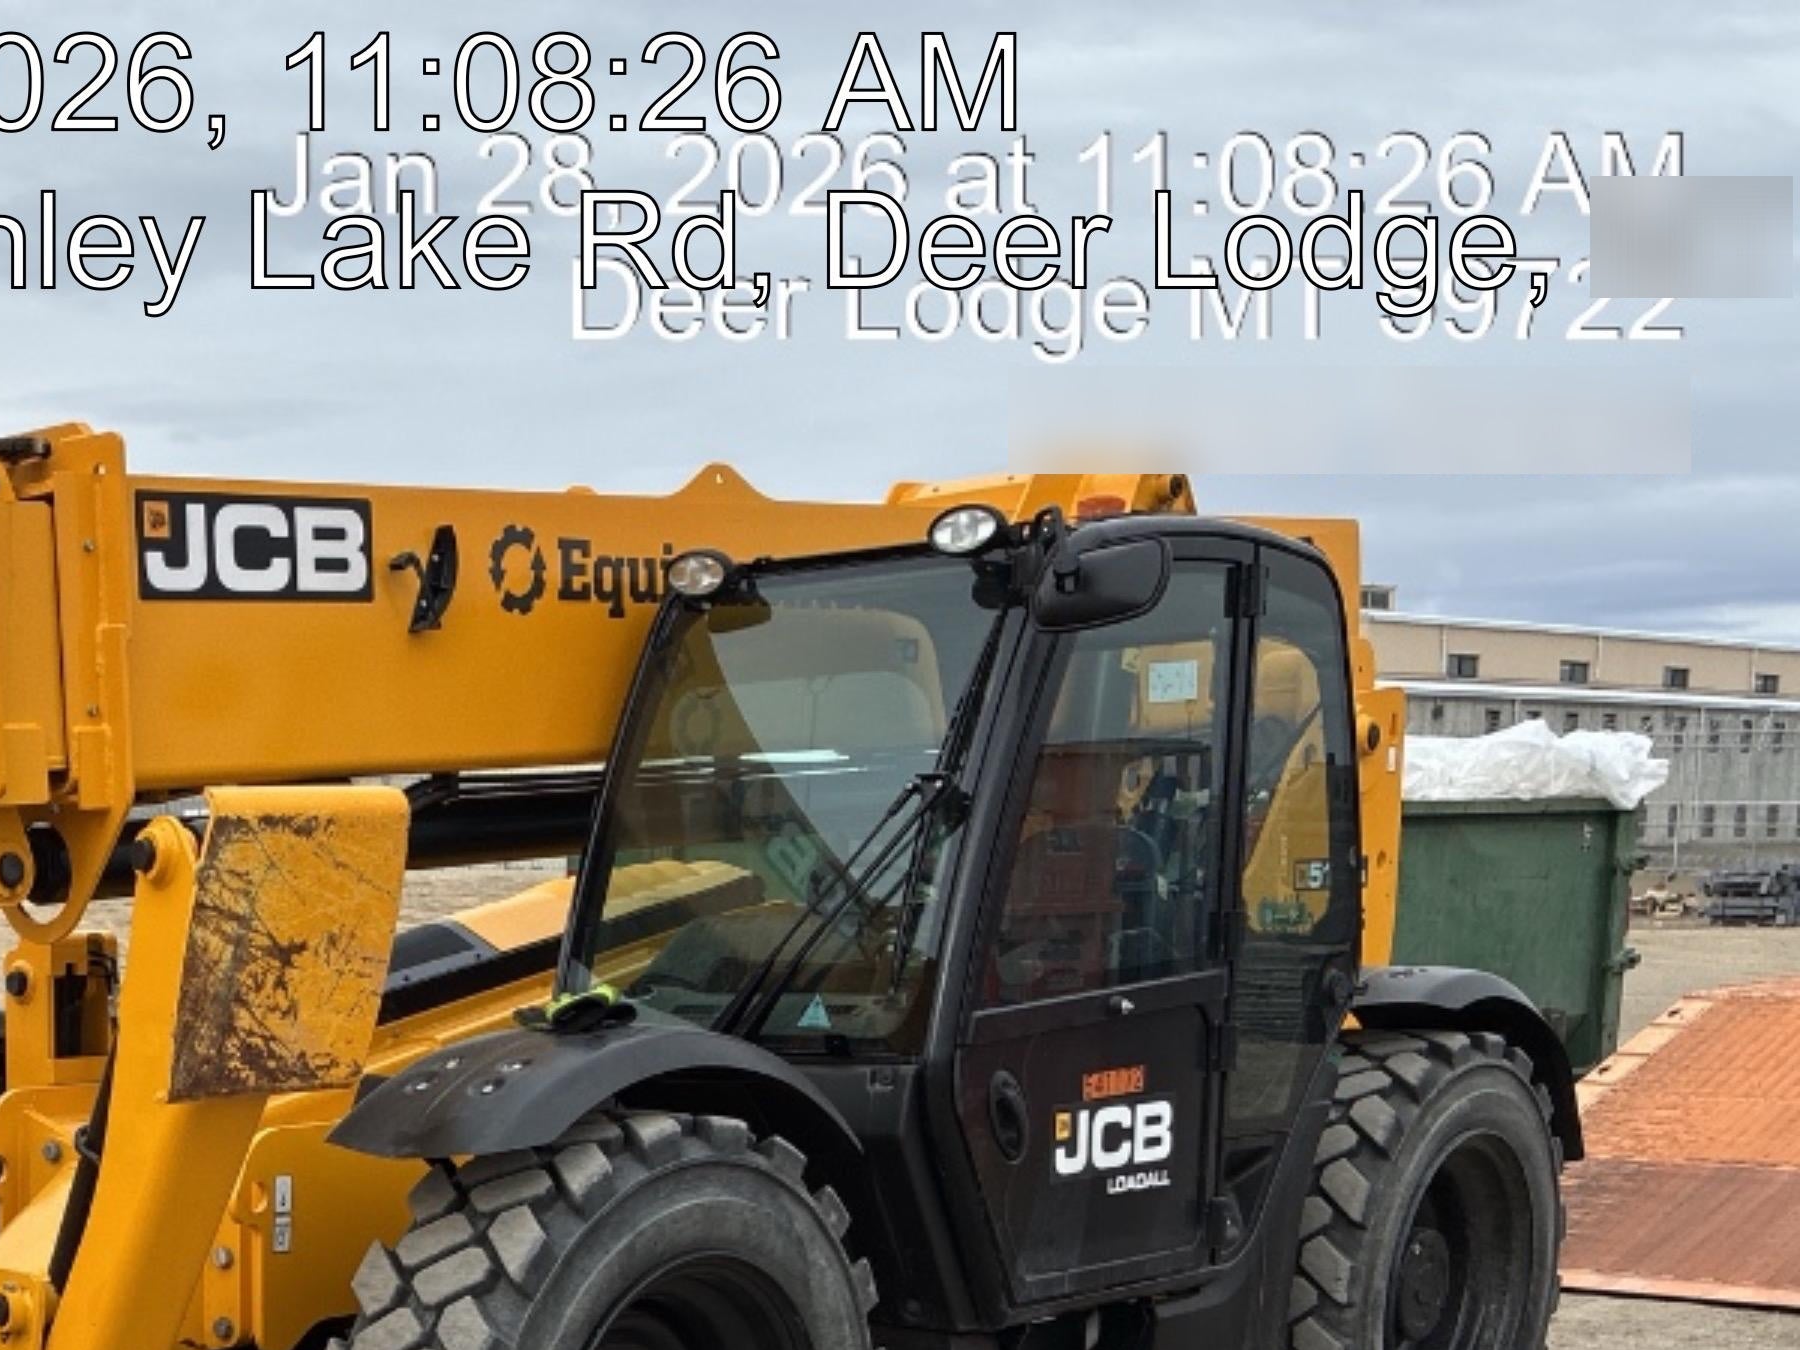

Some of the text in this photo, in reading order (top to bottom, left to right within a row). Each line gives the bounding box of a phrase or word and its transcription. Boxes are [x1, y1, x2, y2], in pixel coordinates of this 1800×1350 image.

[144, 502, 367, 593] JCB
[1054, 1100, 1173, 1175] JCB
[1106, 1169, 1171, 1195] LOADALL
